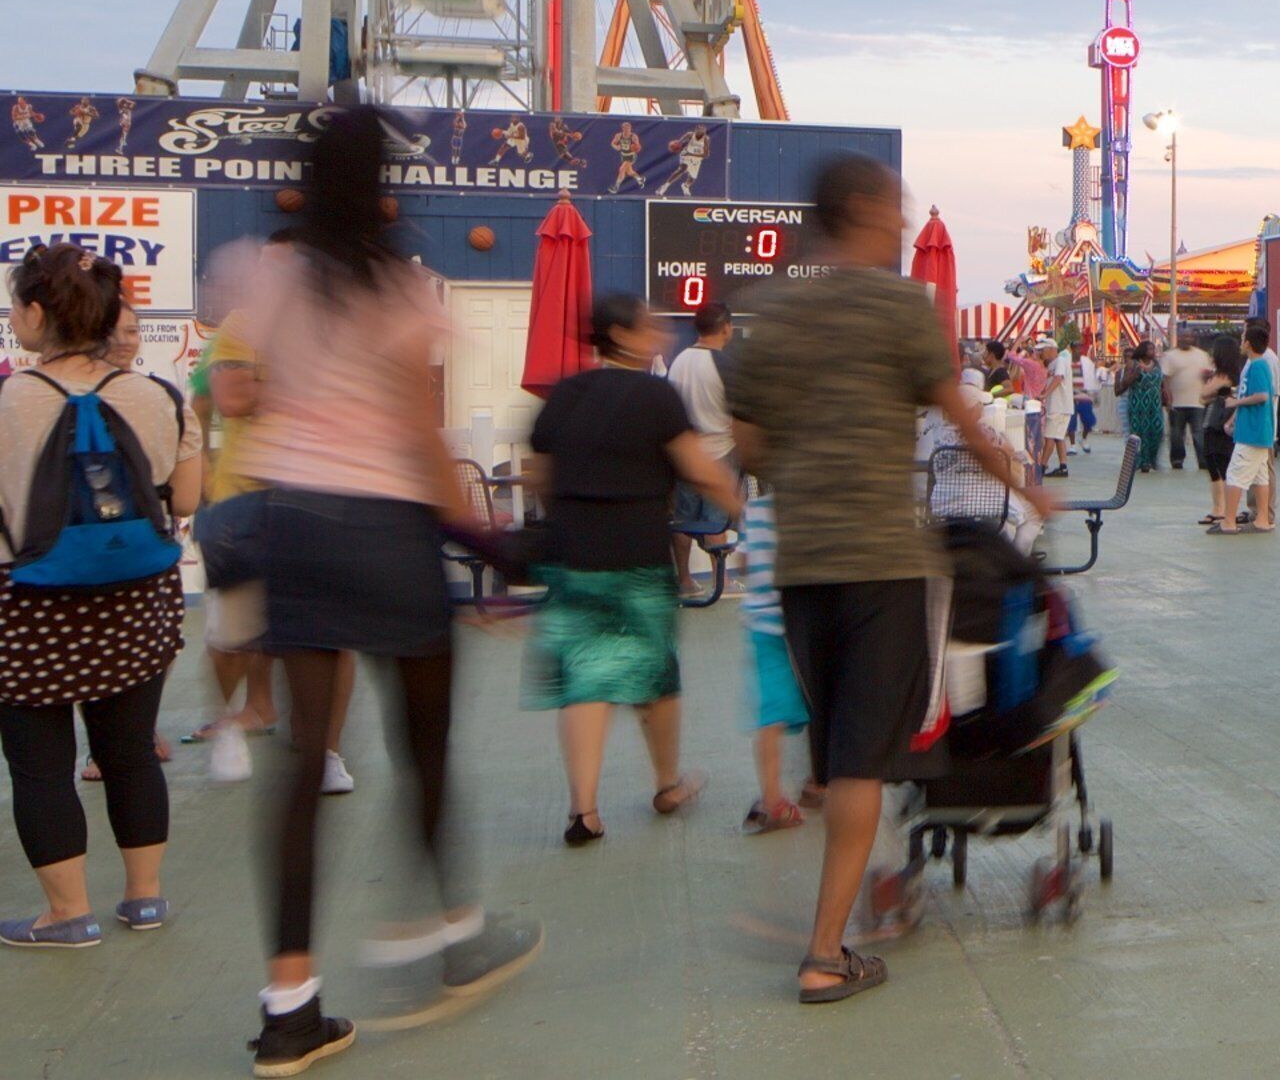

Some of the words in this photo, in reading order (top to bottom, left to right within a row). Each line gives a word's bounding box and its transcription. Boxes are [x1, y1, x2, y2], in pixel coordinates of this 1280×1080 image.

[159, 106, 302, 155] Steel
[35, 154, 182, 178] THREE
[194, 158, 313, 180] POIN
[380, 165, 578, 189] HALLENGE
[8, 194, 160, 226] PRIZE
[711, 209, 802, 224] EVERSAN
[657, 261, 707, 277] HOME
[723, 262, 775, 276] PERIOD
[683, 277, 704, 305] 0
[144, 334, 180, 344] LOCATION
[156, 324, 177, 334] FROM
